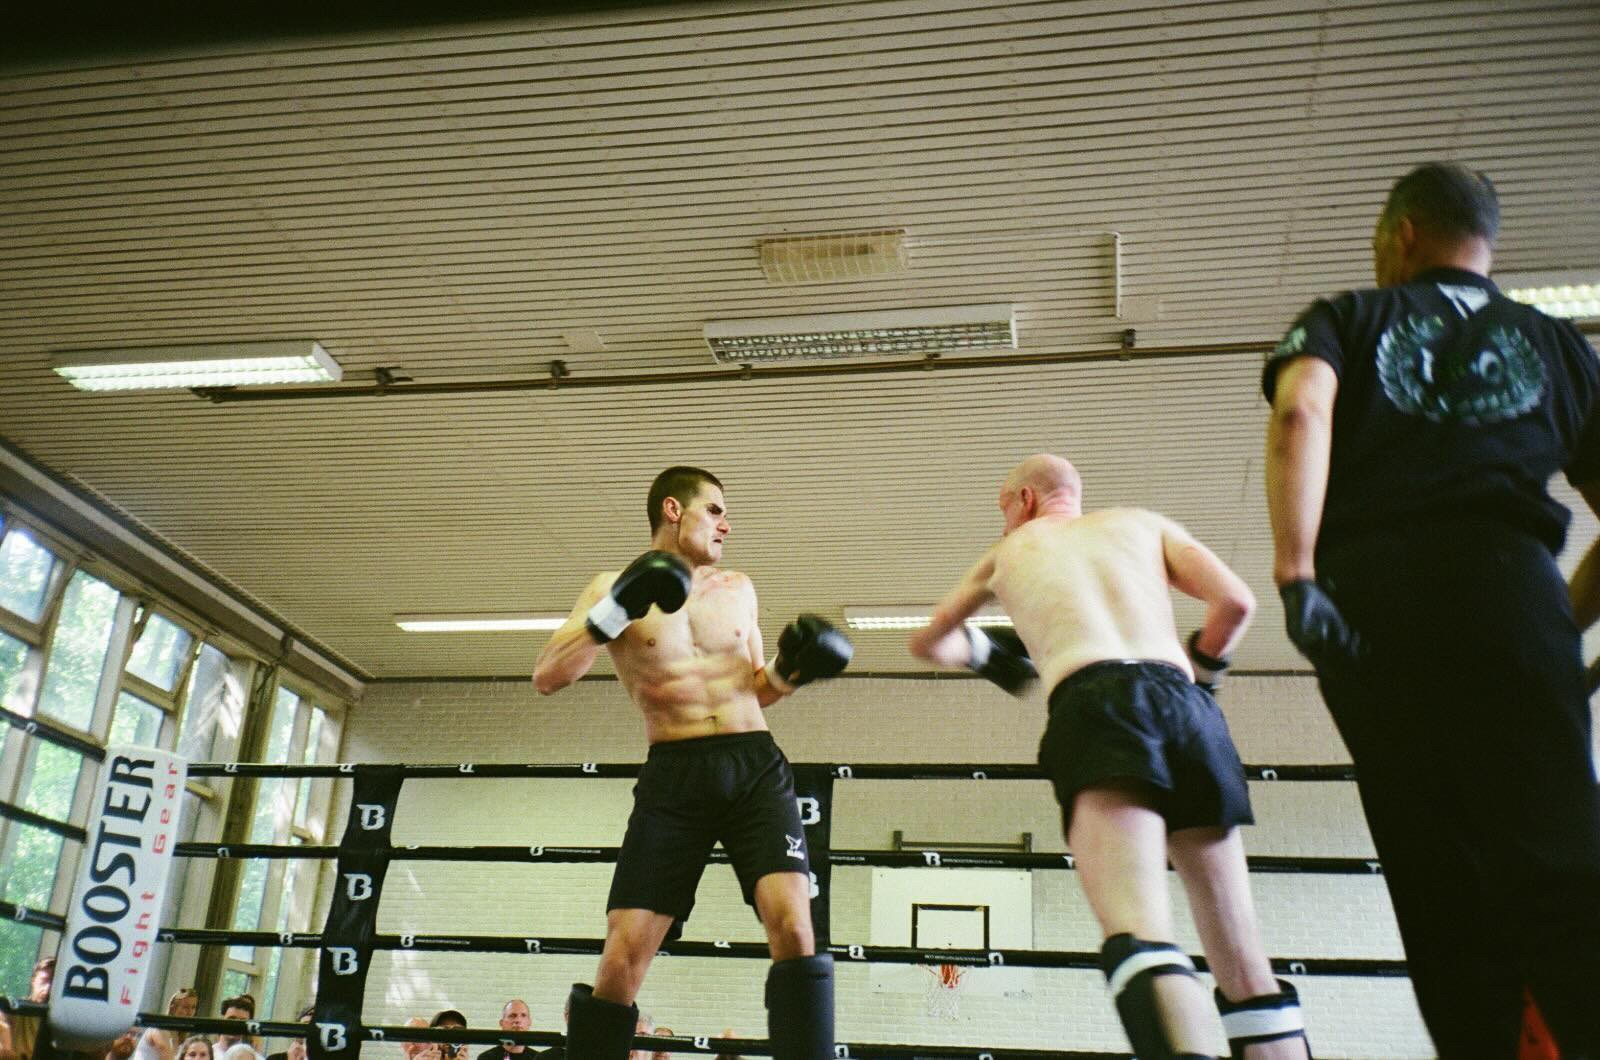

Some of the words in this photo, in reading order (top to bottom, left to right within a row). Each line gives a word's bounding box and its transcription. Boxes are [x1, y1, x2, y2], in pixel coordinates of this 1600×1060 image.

[356, 804, 385, 831] B
[62, 755, 155, 1003] BOOSTER
[119, 891, 155, 1005] Fight
[151, 762, 178, 854] Gear
[344, 873, 373, 901] B
[326, 947, 358, 976] B
[314, 1022, 347, 1052] B
